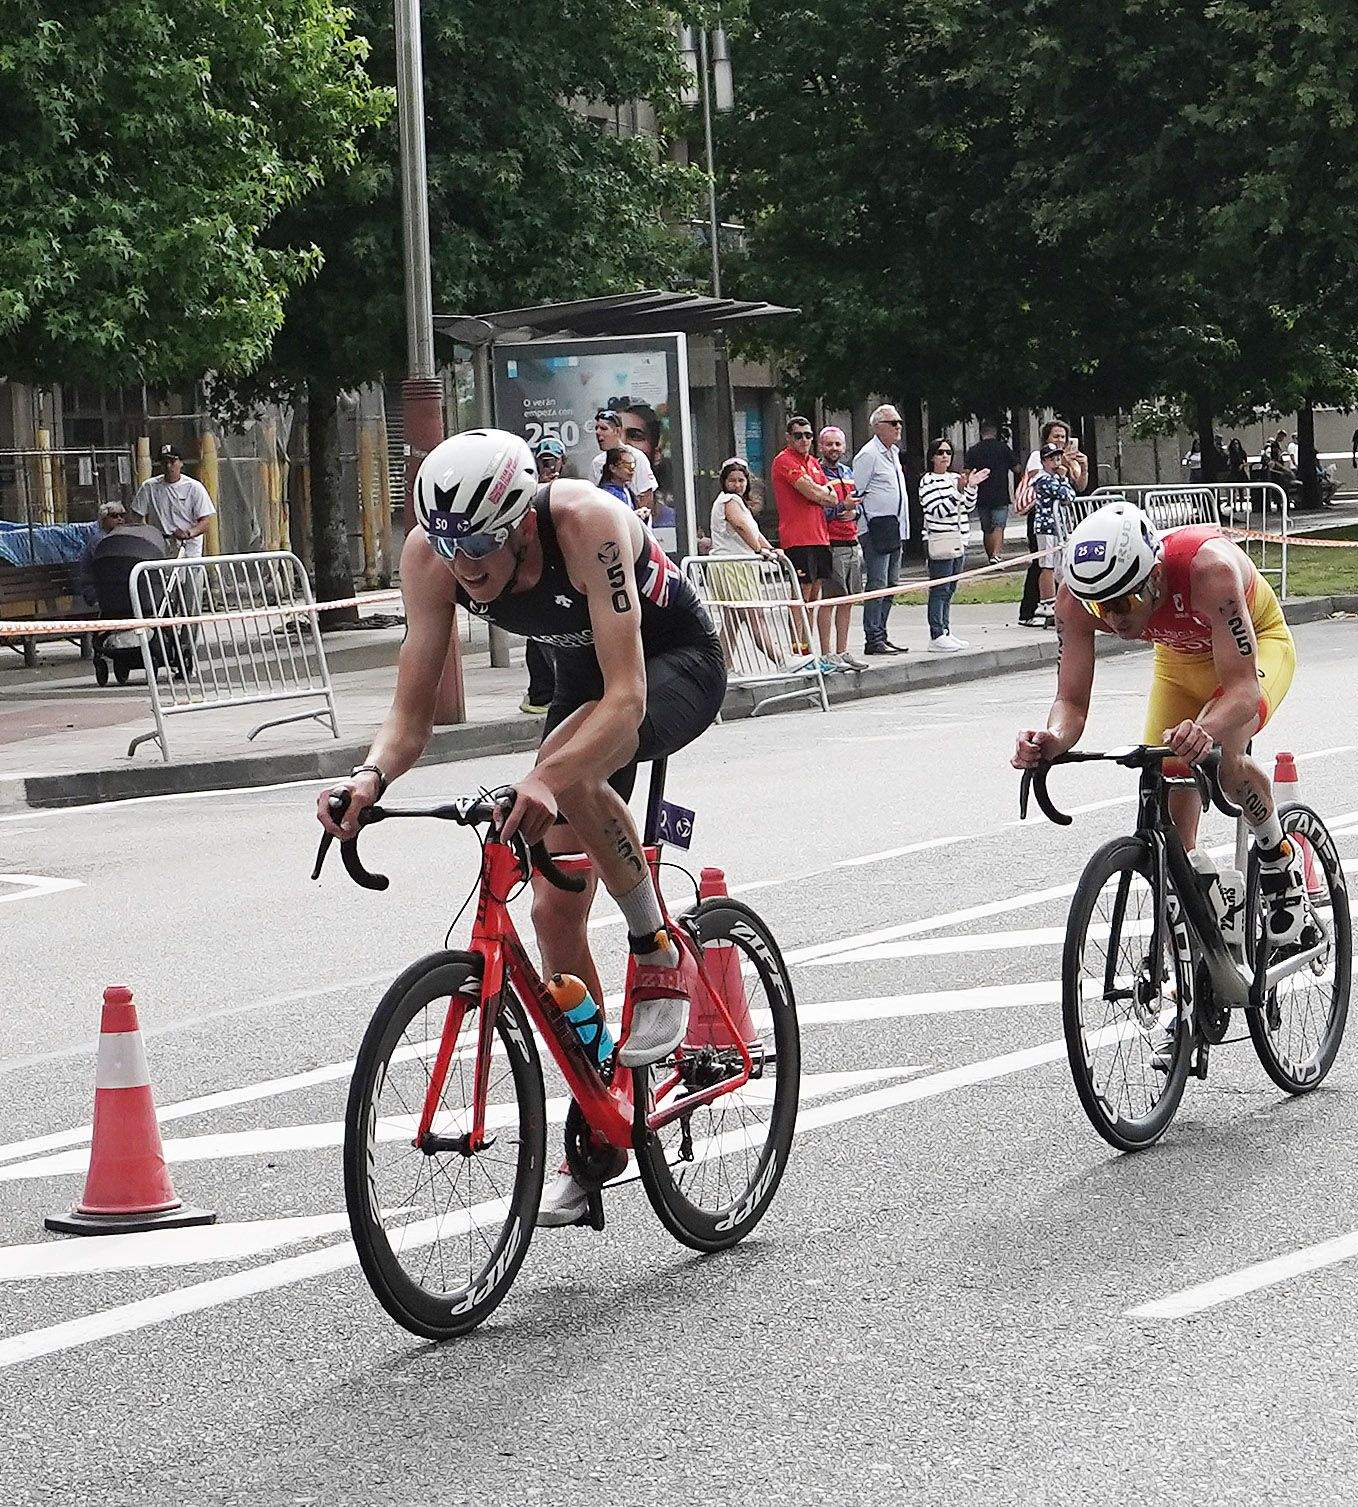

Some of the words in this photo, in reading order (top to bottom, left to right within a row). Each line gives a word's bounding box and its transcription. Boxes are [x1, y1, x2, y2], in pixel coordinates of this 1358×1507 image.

[523, 399, 531, 407] O
[525, 420, 580, 449] 250
[435, 518, 448, 530] 50
[606, 562, 632, 614] 50
[1227, 616, 1253, 657] 25
[730, 920, 788, 1006] ZIPP
[714, 1148, 777, 1231] ZIPP
[450, 1216, 521, 1315] ZIPP
